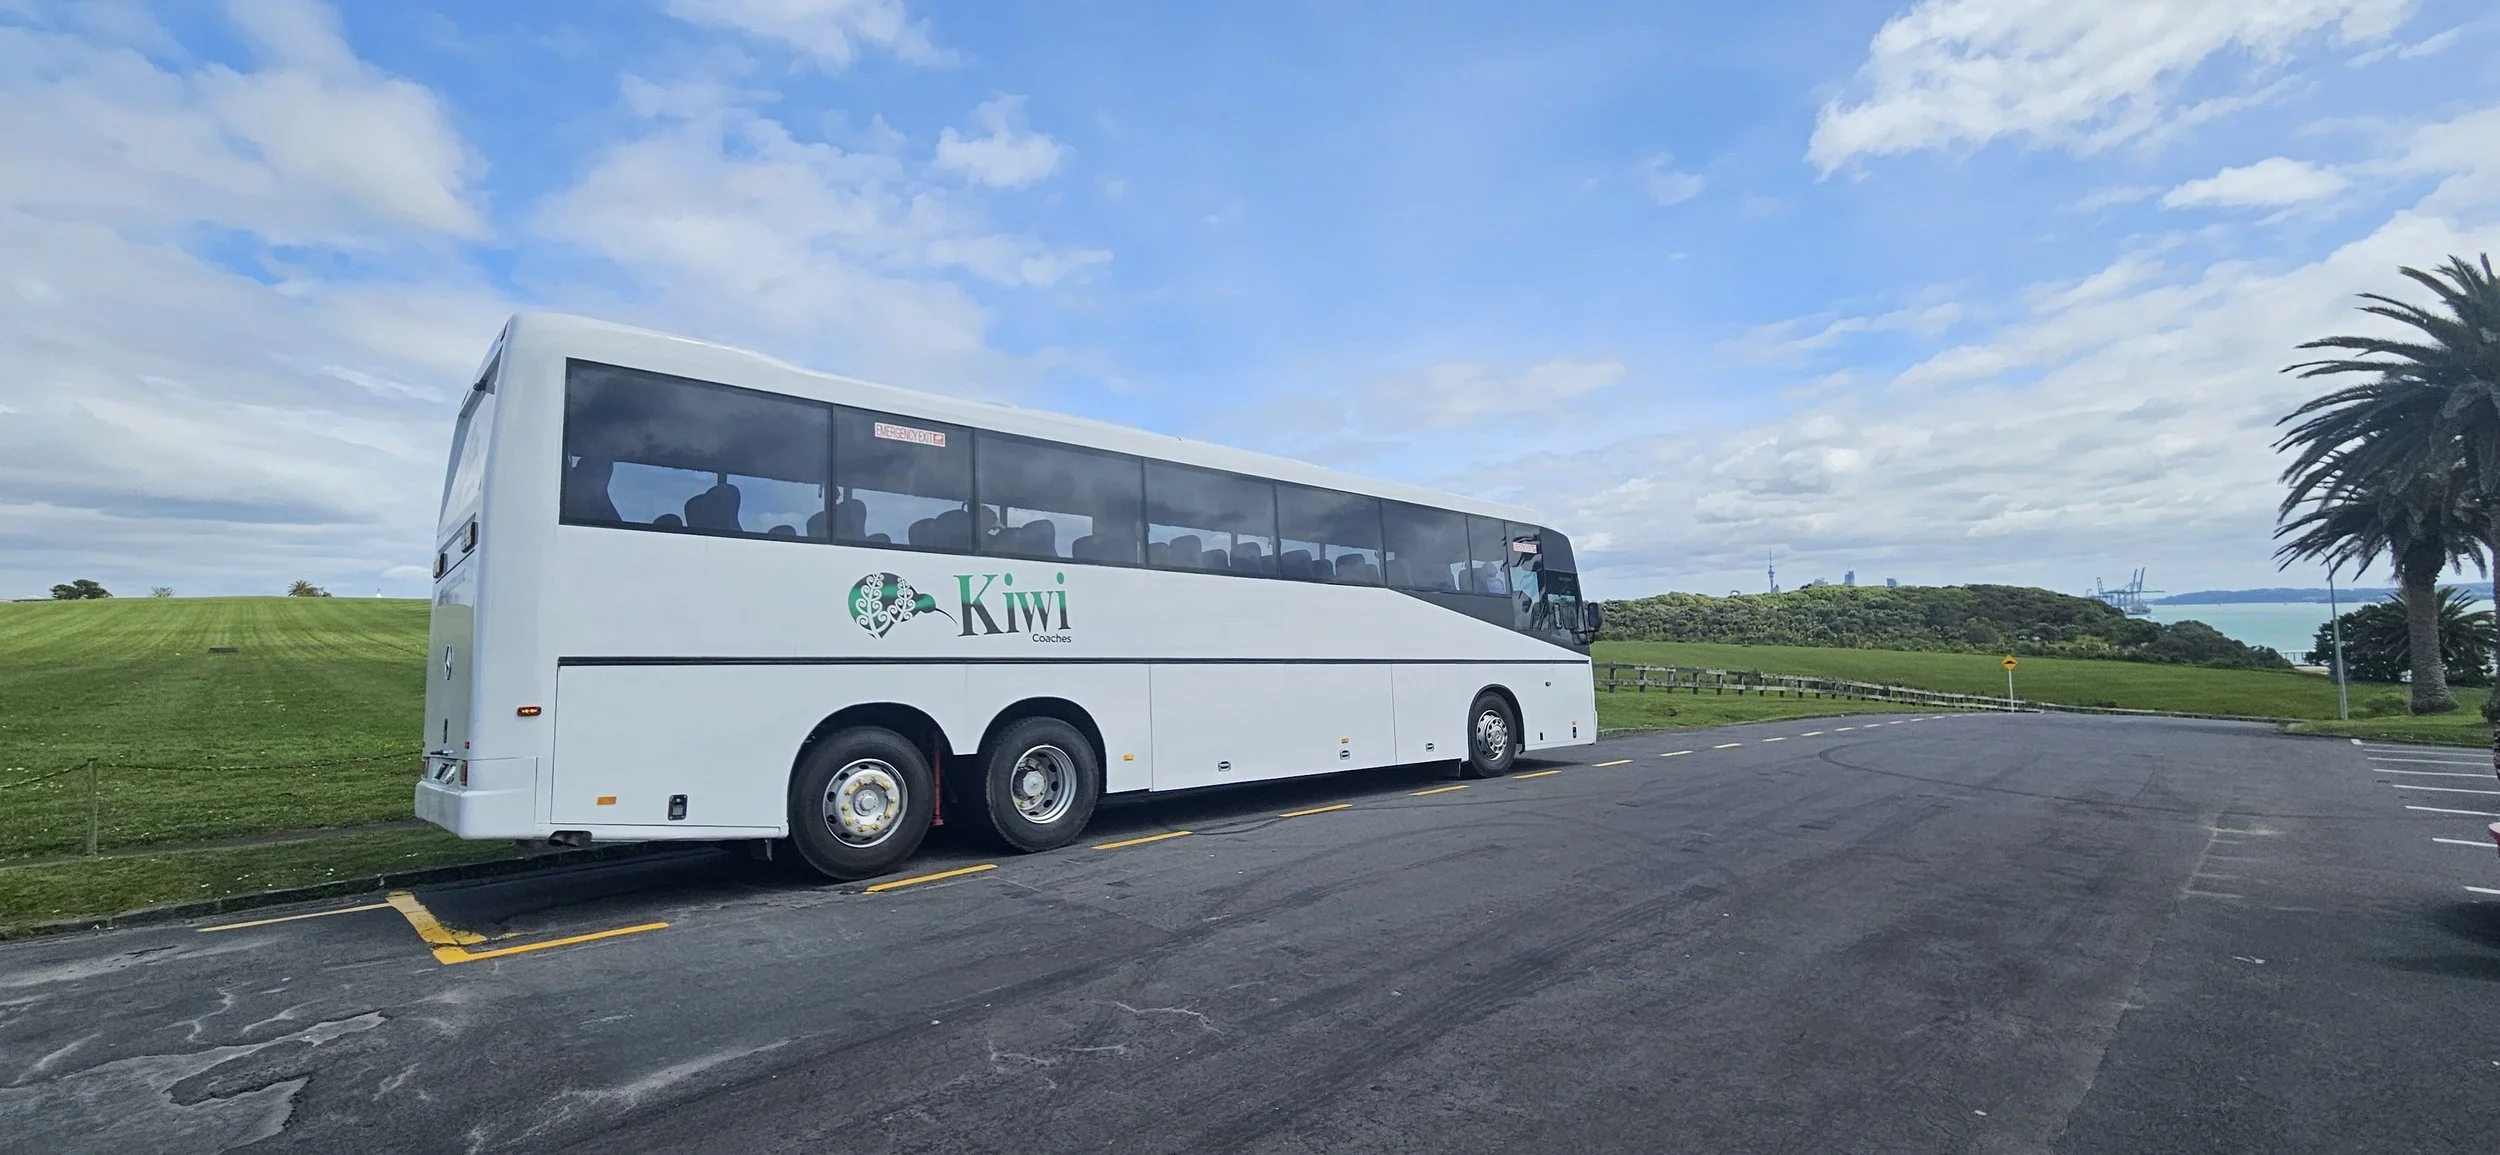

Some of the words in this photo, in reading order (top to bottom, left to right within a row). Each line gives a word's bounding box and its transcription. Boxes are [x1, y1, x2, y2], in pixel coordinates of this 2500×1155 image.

[876, 424, 918, 441] EMERGENCY
[918, 431, 933, 443] EXIT
[953, 572, 1072, 637] Kiwi
[1032, 633, 1072, 643] Coaches
